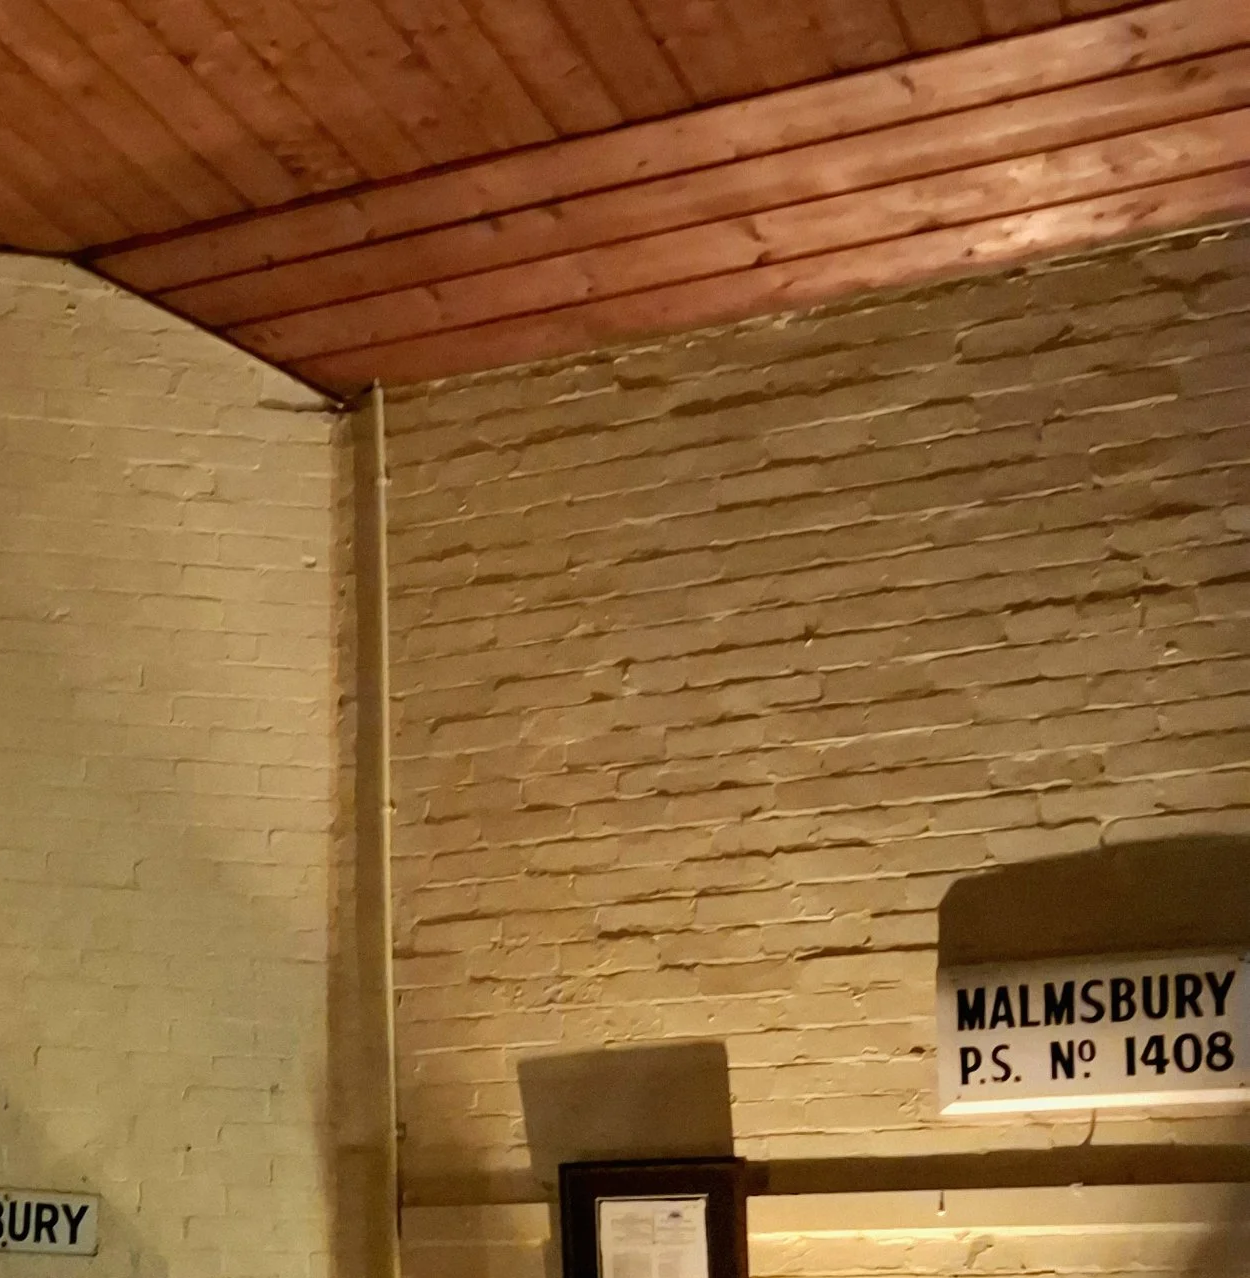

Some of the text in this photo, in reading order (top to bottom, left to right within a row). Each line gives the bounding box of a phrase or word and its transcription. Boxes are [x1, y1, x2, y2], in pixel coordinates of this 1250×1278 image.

[956, 969, 1236, 1032] MALMSBURY
[958, 1043, 1023, 1086] P.S.
[1125, 1030, 1235, 1077] 1408
